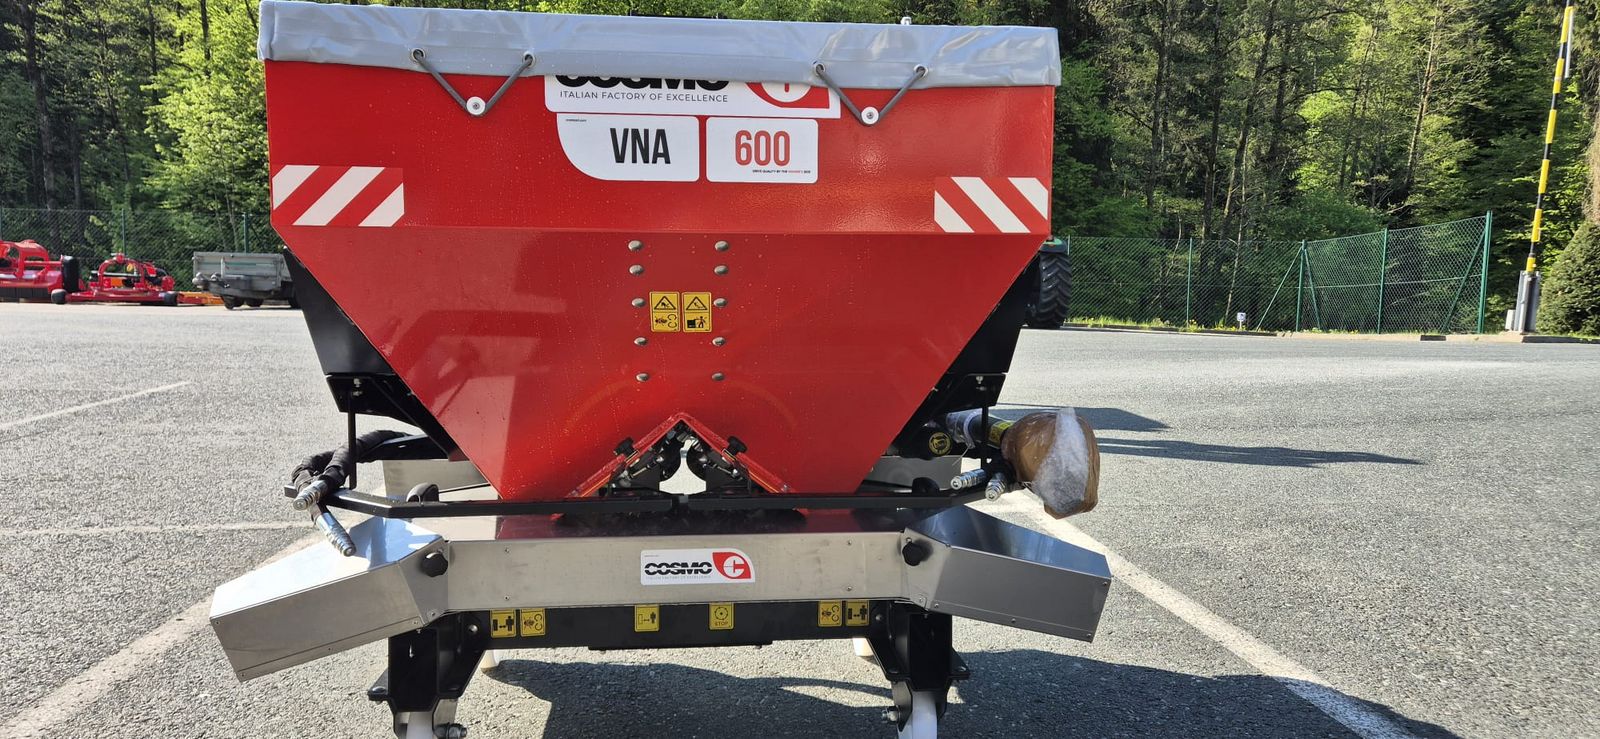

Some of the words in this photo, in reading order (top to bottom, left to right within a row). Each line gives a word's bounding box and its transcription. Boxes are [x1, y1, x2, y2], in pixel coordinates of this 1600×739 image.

[560, 90, 598, 99] ITALIAN
[601, 92, 645, 100] FACTORY
[649, 93, 663, 101] OF
[666, 93, 728, 103] EXCELLENCE
[610, 128, 671, 164] VNA
[735, 130, 790, 167] 600
[644, 562, 713, 576] COSMO
